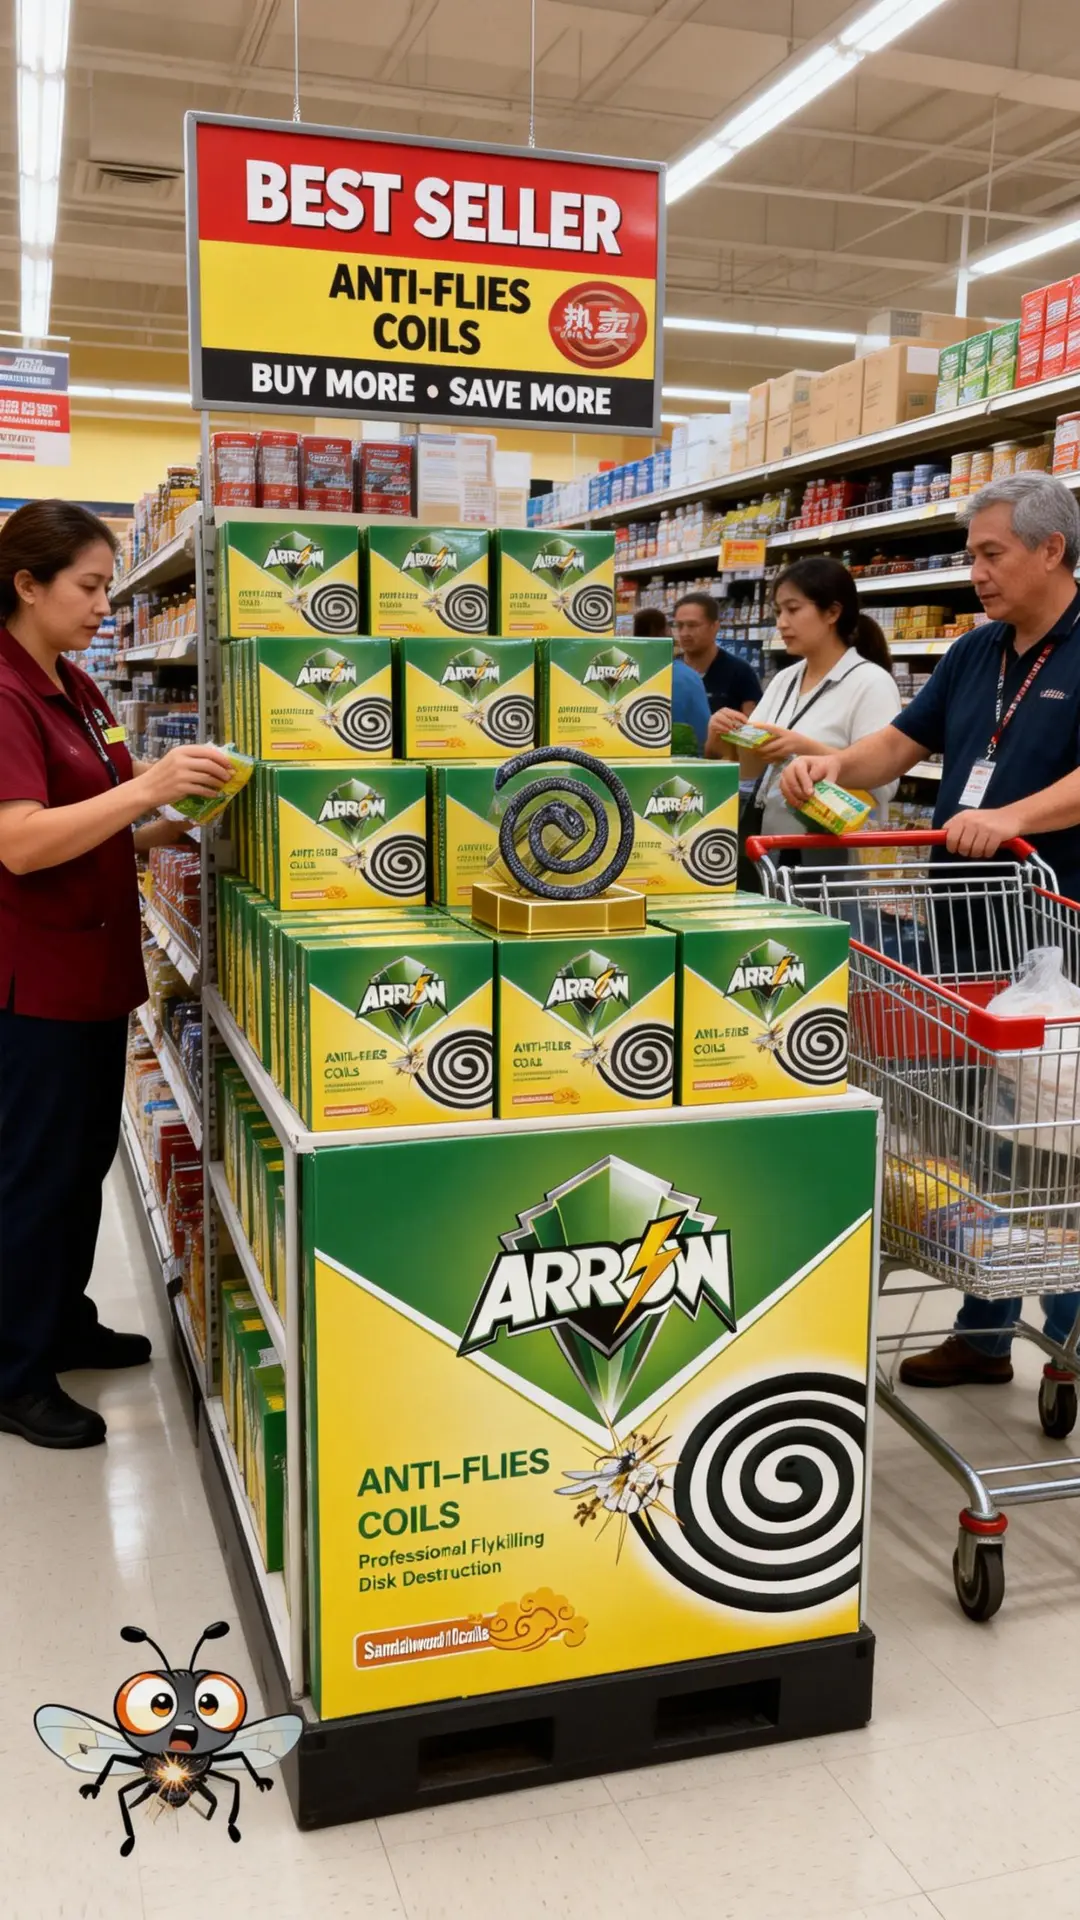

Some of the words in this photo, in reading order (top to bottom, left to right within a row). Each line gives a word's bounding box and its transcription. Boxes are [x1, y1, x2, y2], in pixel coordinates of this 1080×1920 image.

[246, 159, 402, 234] BEST
[413, 176, 623, 256] SELLER
[329, 263, 531, 315] ANTI-FLIES
[373, 312, 481, 355] COILS
[251, 363, 316, 397] BUY
[326, 369, 415, 403] MORE
[448, 377, 521, 410] SAVE
[530, 383, 612, 416] MORE
[543, 975, 631, 1010] ARROW
[458, 1229, 736, 1357] ARROW
[356, 1447, 550, 1498] ANTI-FLIES
[357, 1501, 461, 1541] COILS
[359, 1573, 397, 1593] Disk
